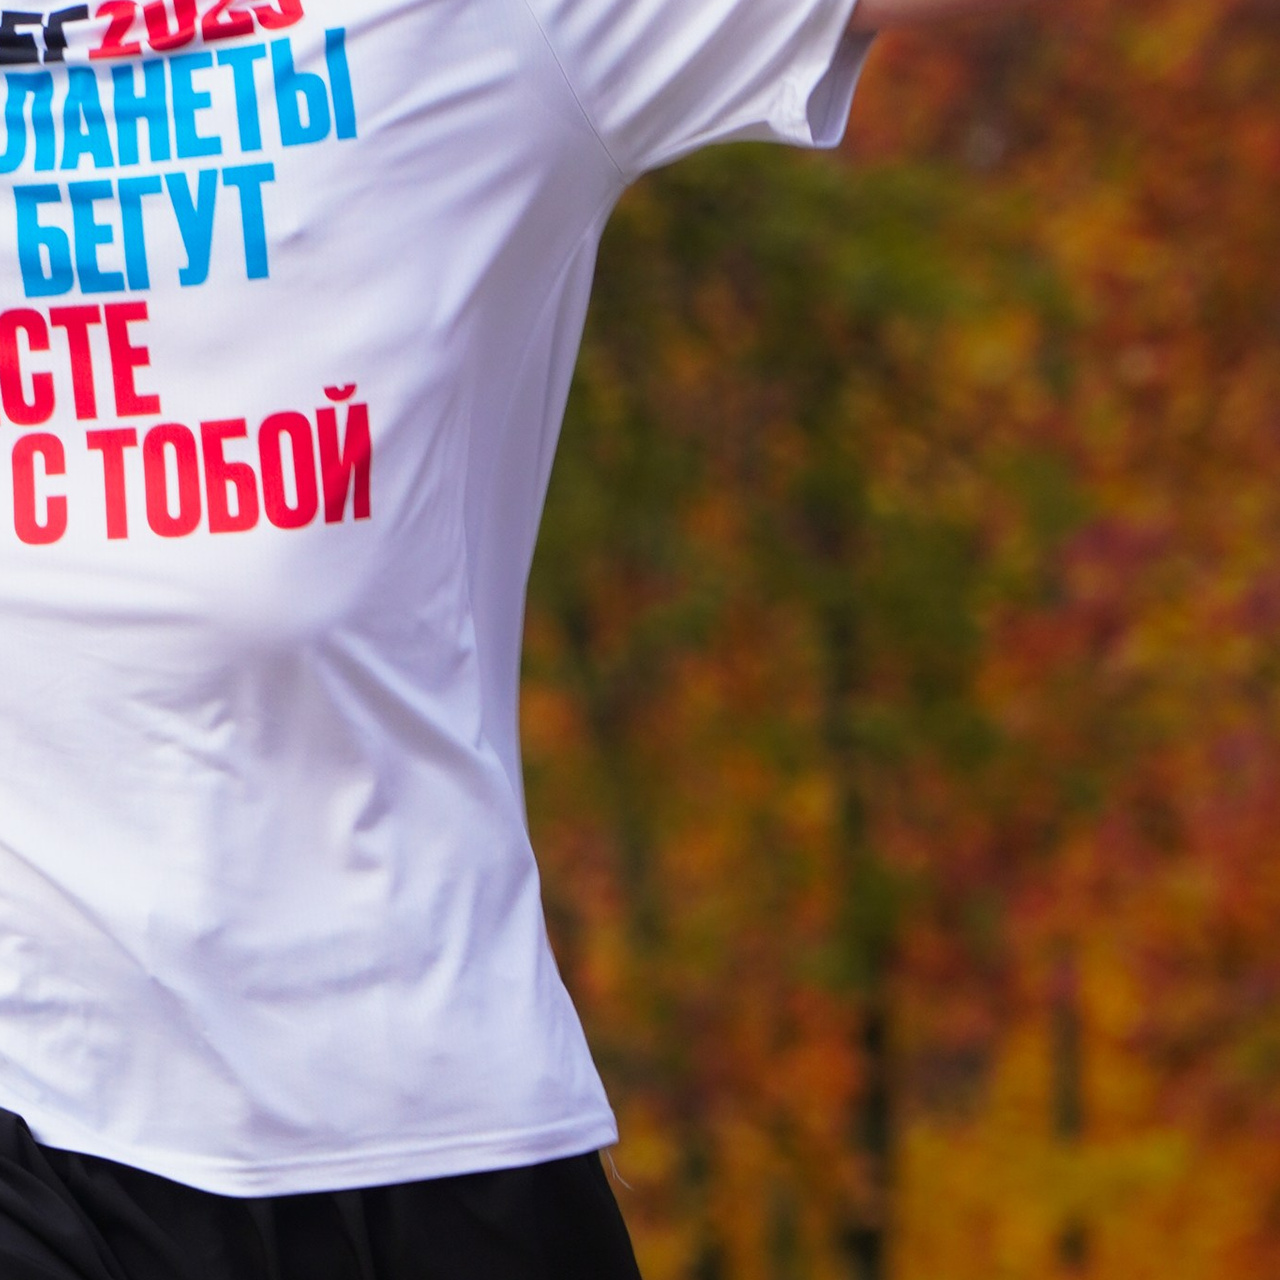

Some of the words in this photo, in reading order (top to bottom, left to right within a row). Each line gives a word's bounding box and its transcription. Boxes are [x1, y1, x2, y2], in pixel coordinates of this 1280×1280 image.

[11, 161, 276, 299] БЕГУТ
[11, 432, 68, 545] С
[85, 383, 373, 540] ТОБОЙ
